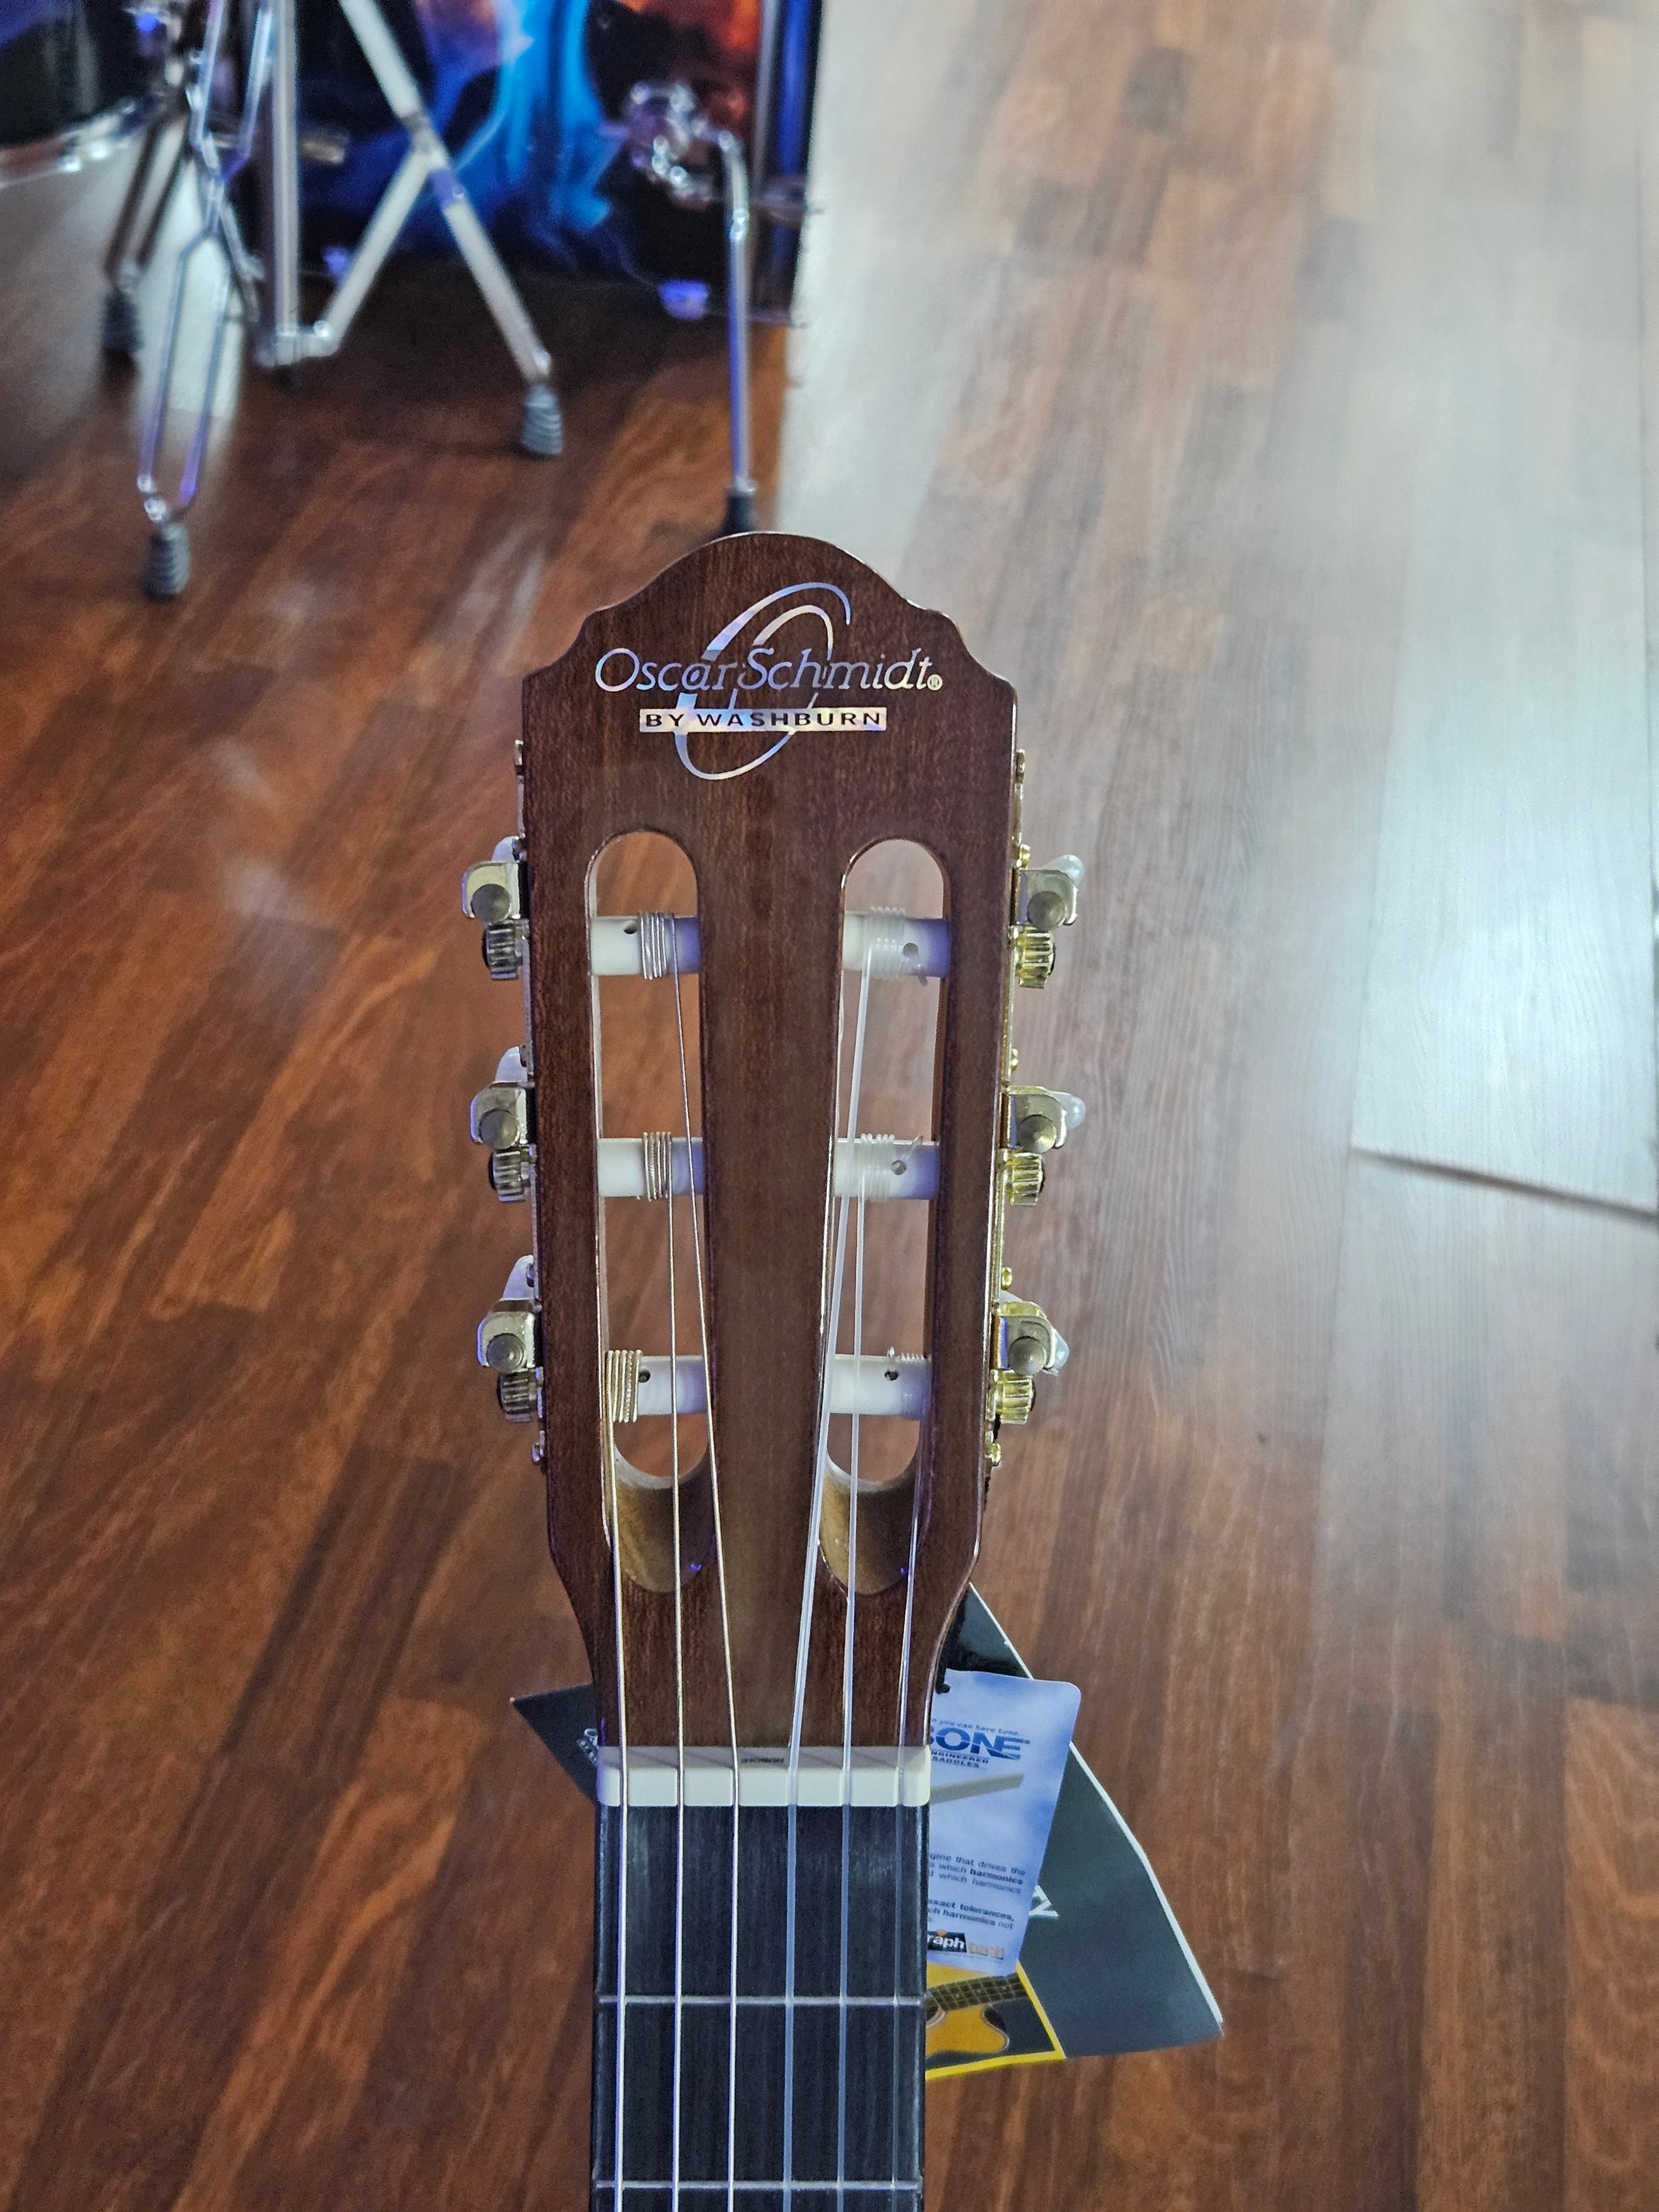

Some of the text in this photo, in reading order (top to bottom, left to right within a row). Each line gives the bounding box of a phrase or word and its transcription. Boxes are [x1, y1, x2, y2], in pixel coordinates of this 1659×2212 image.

[645, 712, 880, 728] BY WASHBURN
[930, 1725, 1031, 1761] ONE
[931, 1750, 989, 1764] NGINEERED
[930, 1853, 1026, 1876] gine that drives the
[938, 1863, 967, 1874] which
[969, 1868, 1023, 1885] harmonics
[938, 1872, 967, 1883] which
[972, 1878, 1021, 1894] harmonics
[942, 1908, 996, 1926] harmonics
[998, 1921, 1014, 1929] not
[927, 1934, 965, 1949] raph
